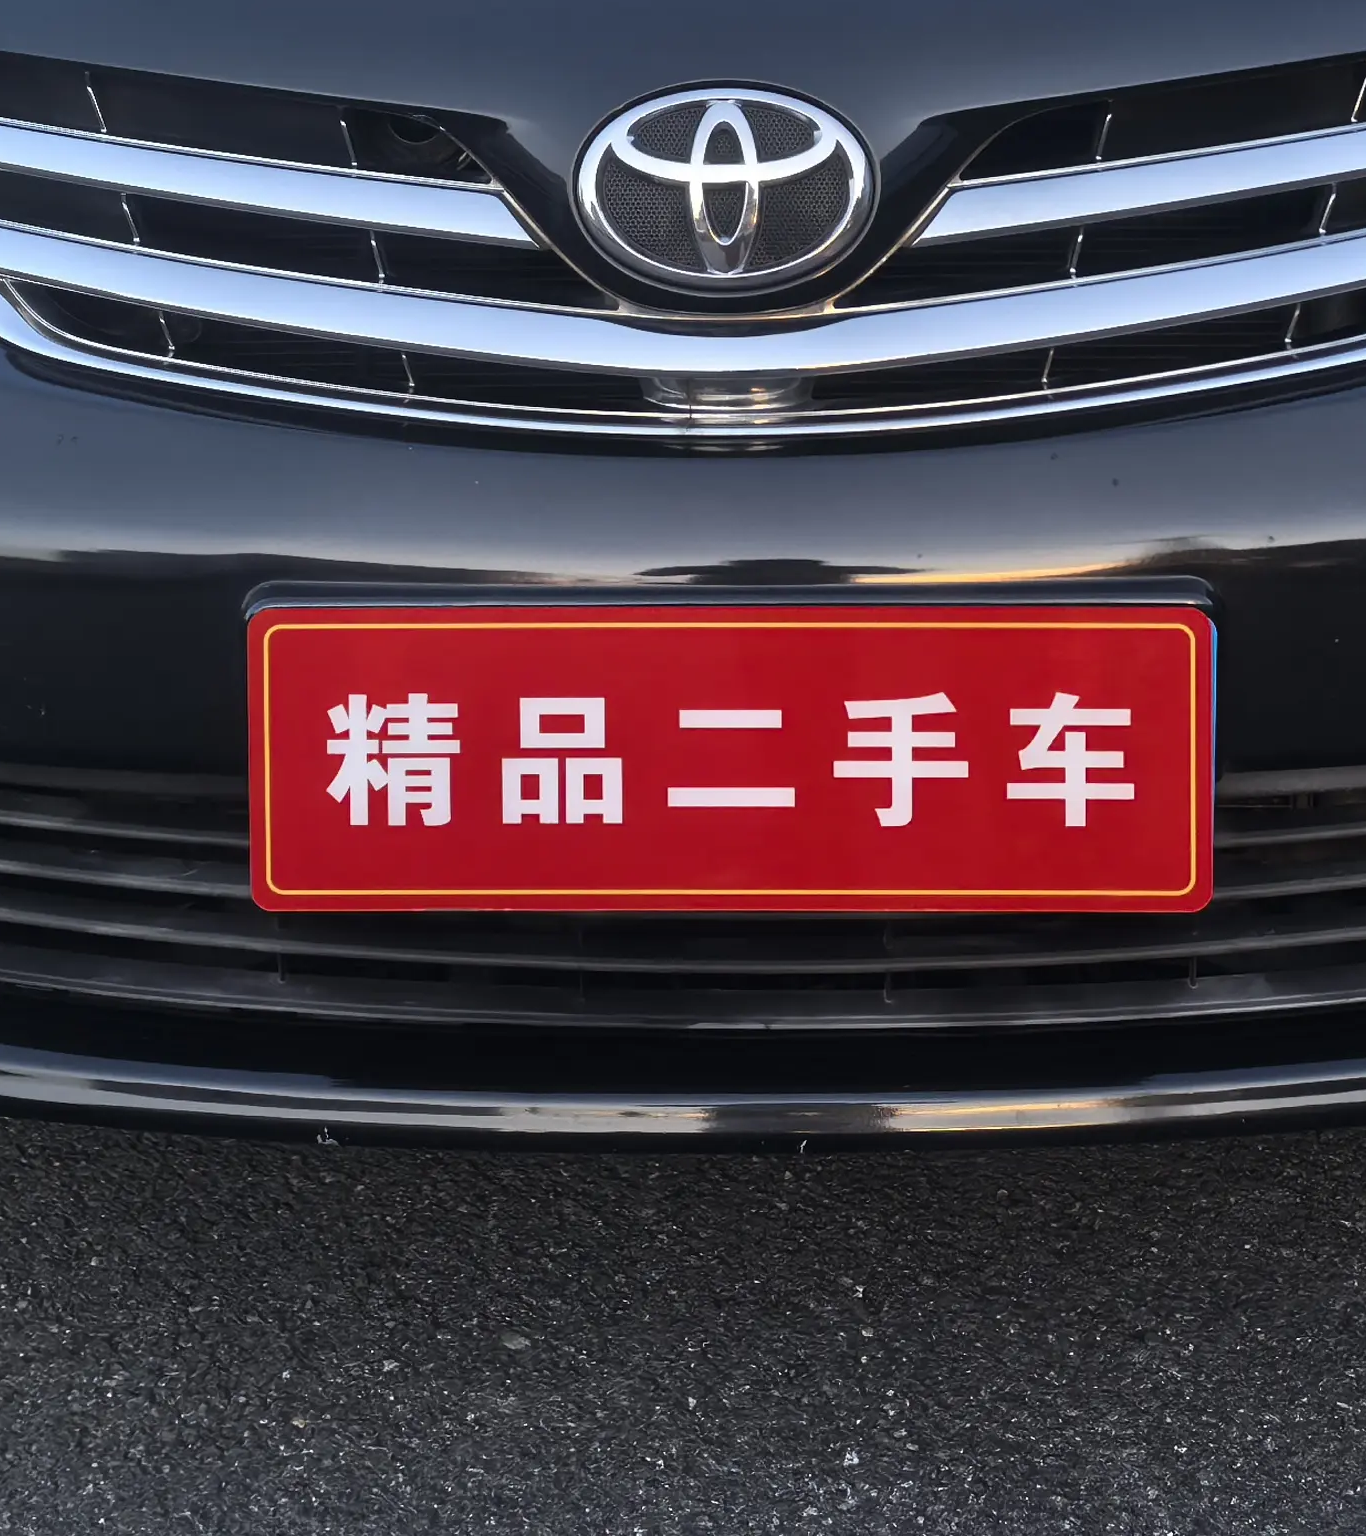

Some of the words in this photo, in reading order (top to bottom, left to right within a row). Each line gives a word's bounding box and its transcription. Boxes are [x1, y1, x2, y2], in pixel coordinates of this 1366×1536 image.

[325, 692, 1135, 828] 精品二手车
